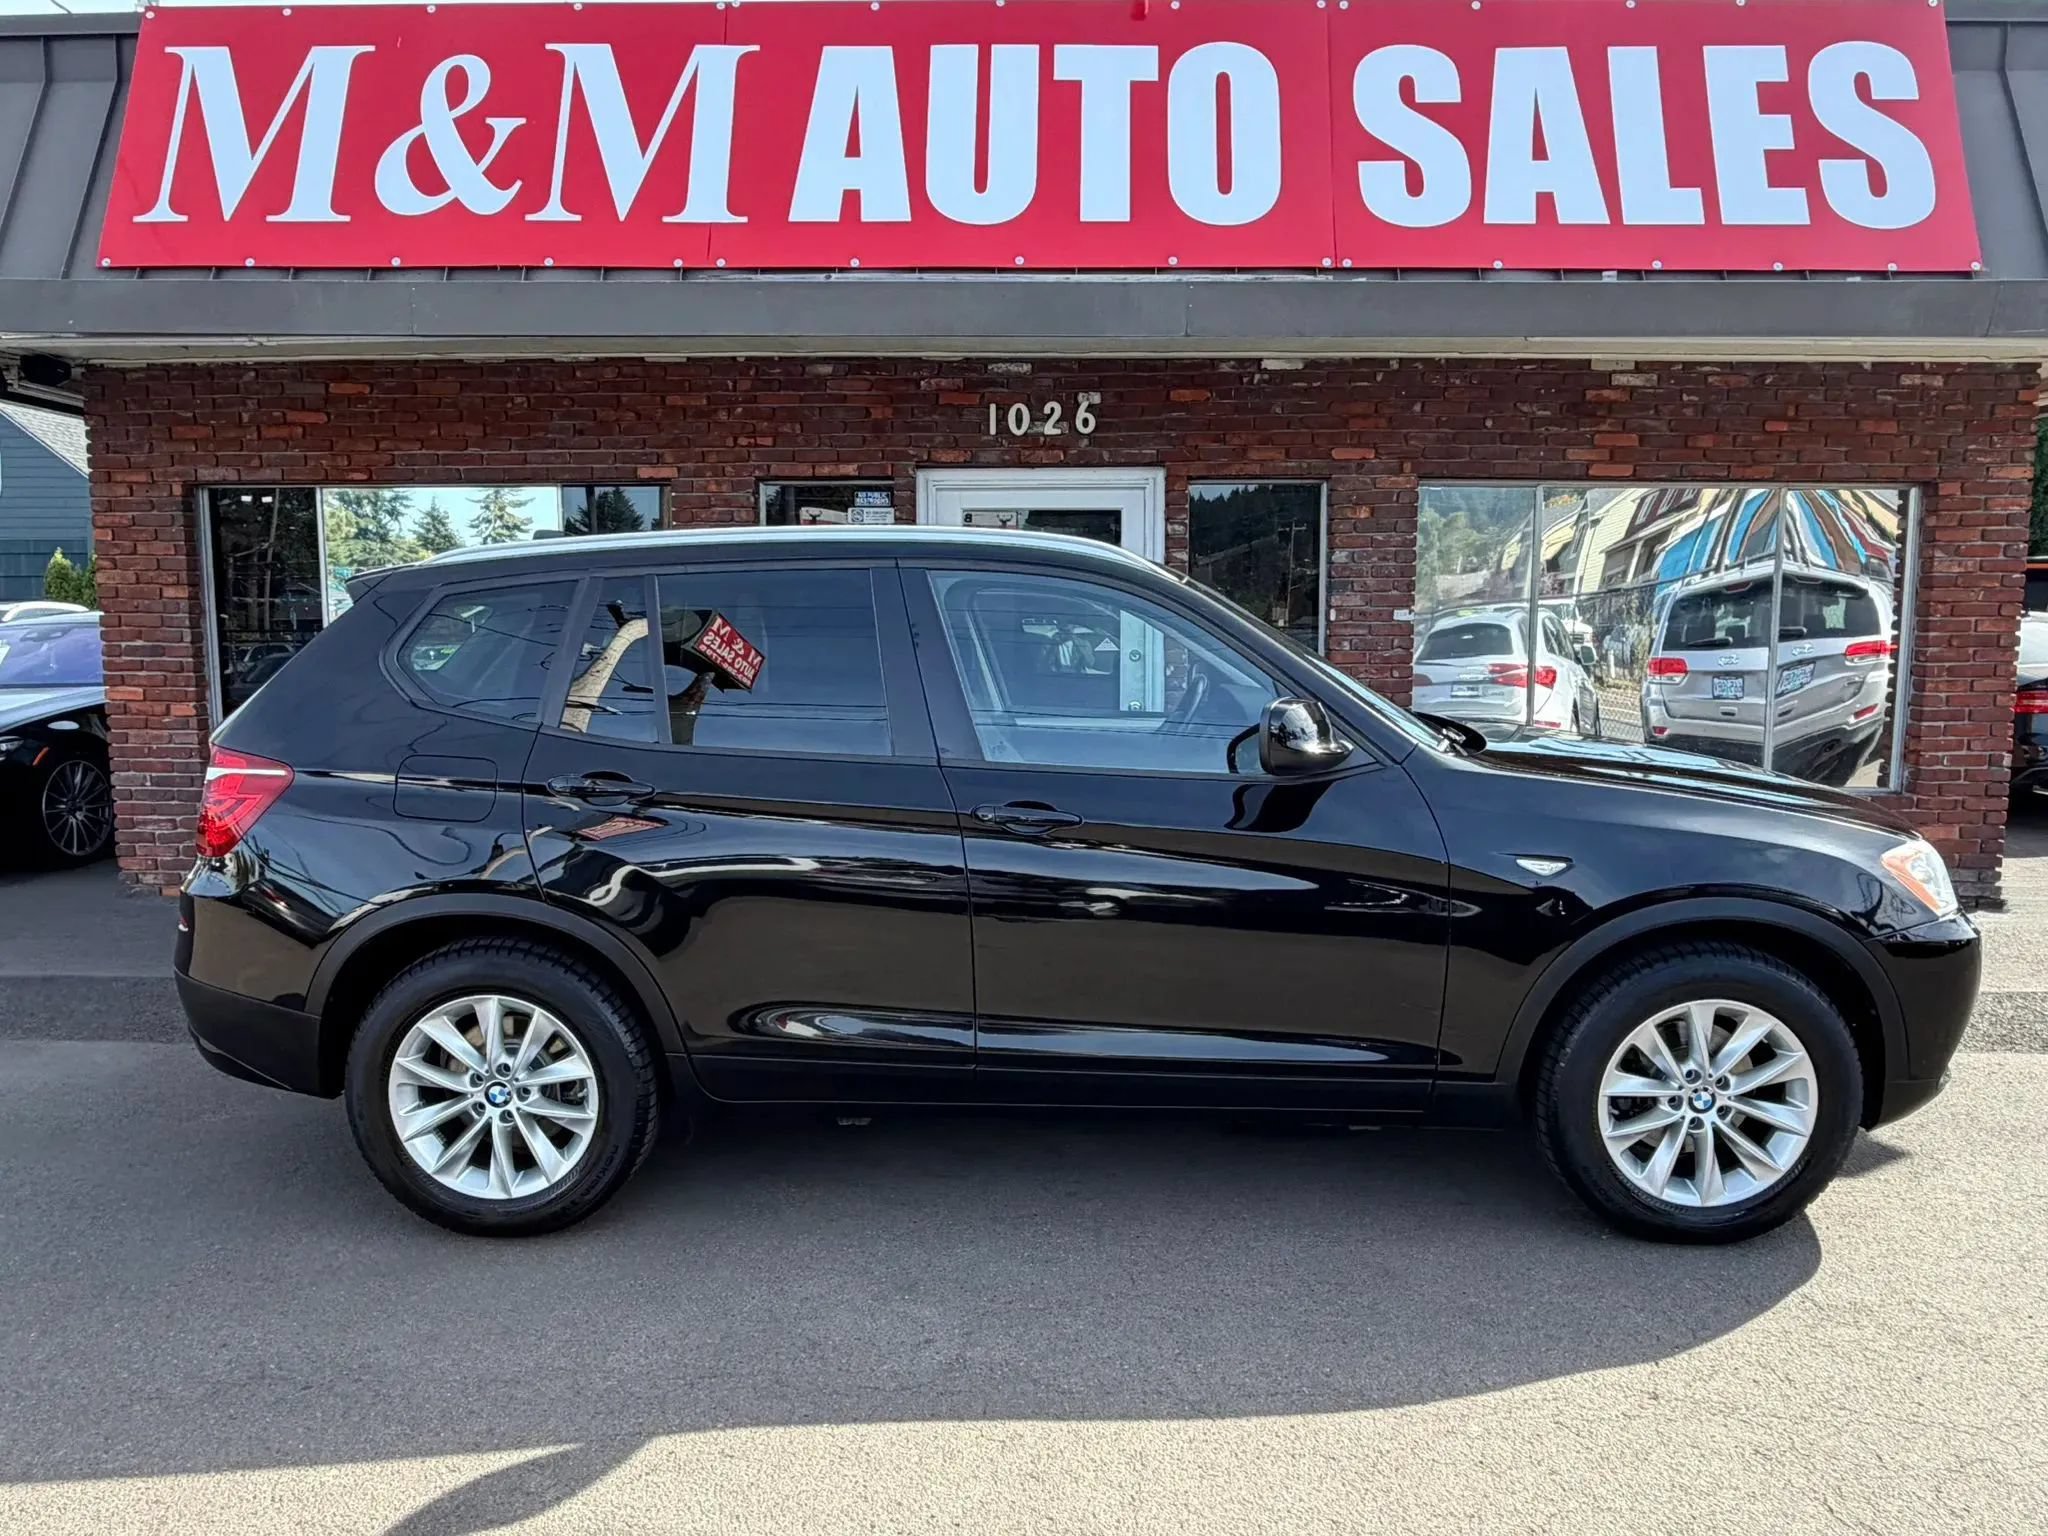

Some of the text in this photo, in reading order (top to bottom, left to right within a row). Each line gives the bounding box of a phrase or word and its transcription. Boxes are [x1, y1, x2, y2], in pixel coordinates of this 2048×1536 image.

[788, 42, 1283, 227] AUTO
[1352, 40, 1937, 230] SALES
[989, 401, 1096, 436] 1026
